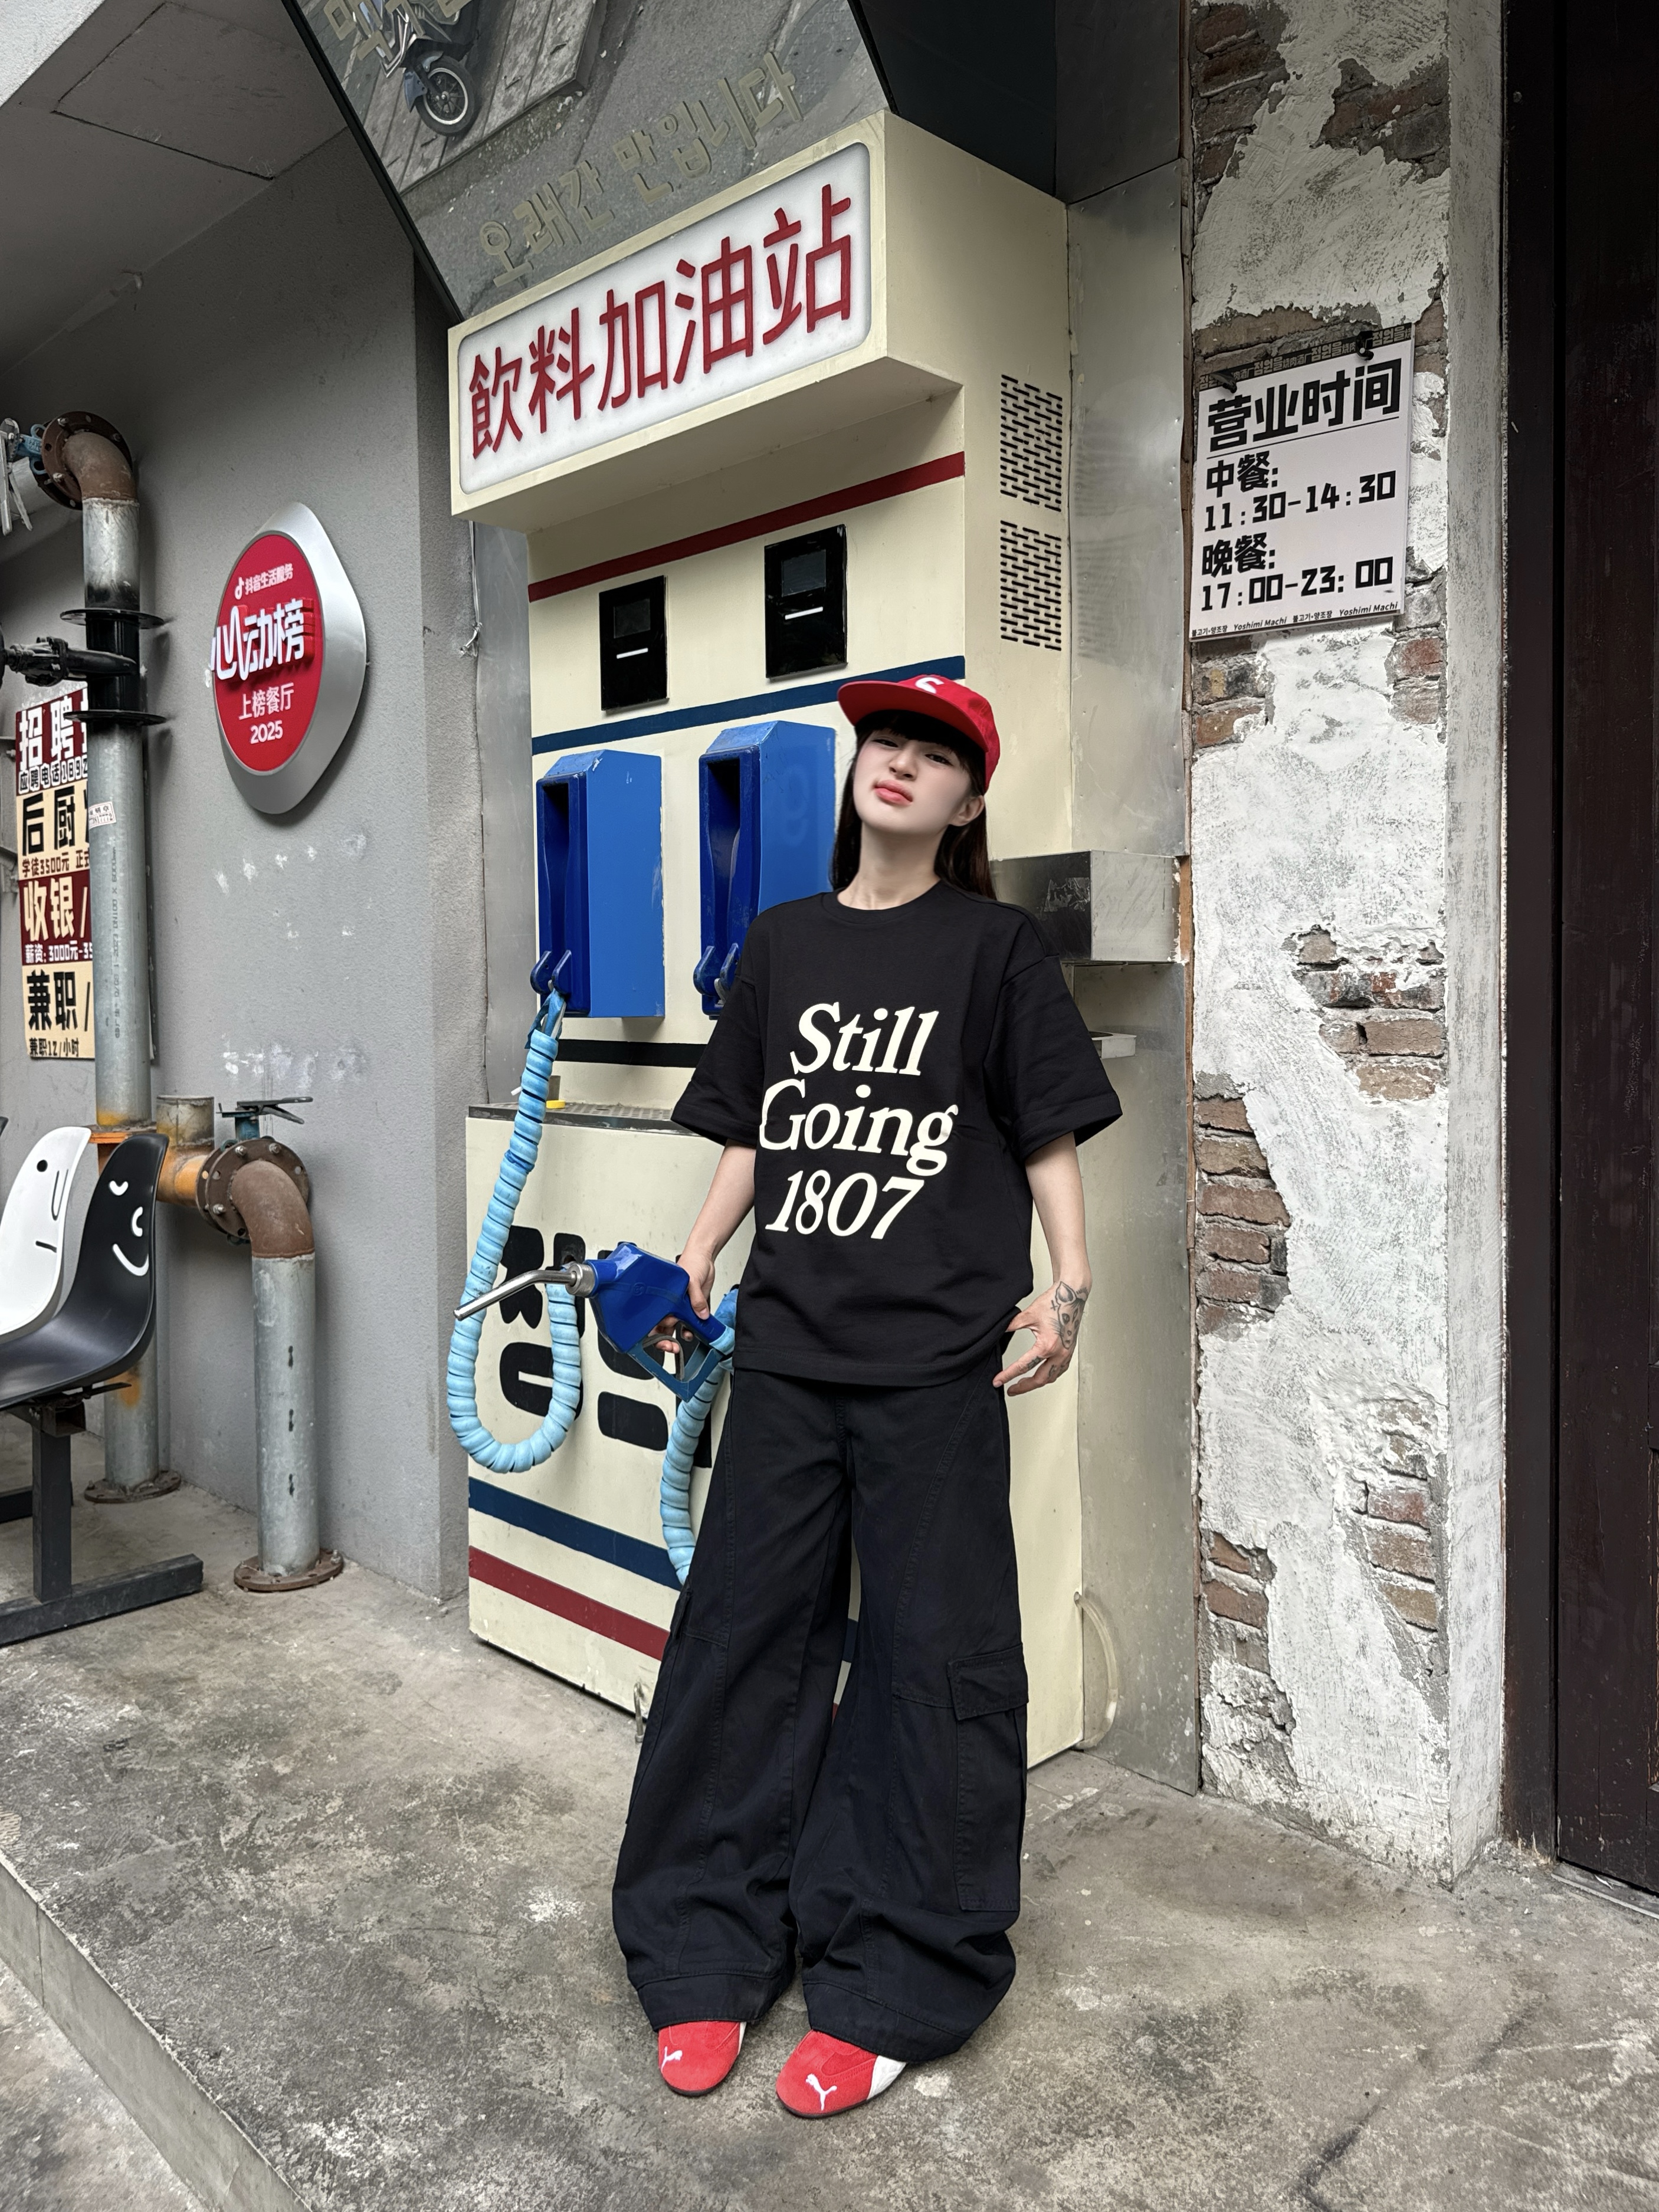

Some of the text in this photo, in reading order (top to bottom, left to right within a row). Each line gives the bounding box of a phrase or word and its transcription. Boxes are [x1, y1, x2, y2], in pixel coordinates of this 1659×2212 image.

[469, 184, 851, 459] 飲料加油站
[1208, 358, 1402, 452] 营业时间
[1204, 470, 1396, 532] 11:30-14:30
[1206, 450, 1278, 498] 中餐:
[245, 563, 294, 595] 抖音生活服务
[1201, 532, 1276, 578] 晚餐:
[209, 598, 304, 681] 心动榜
[1234, 620, 1263, 631] Yoshimi
[1265, 616, 1287, 626] Machi
[1339, 605, 1372, 617] Yoshimi
[1373, 601, 1398, 612] Machi
[19, 688, 88, 772] 招聘
[238, 682, 294, 720] 上榜餐厅
[250, 720, 283, 744] 2025
[22, 785, 89, 856] 后厨
[22, 851, 70, 878] 学徒3500元
[790, 1002, 939, 1076] Still
[759, 1078, 959, 1176] Going
[765, 1170, 924, 1239] 1807
